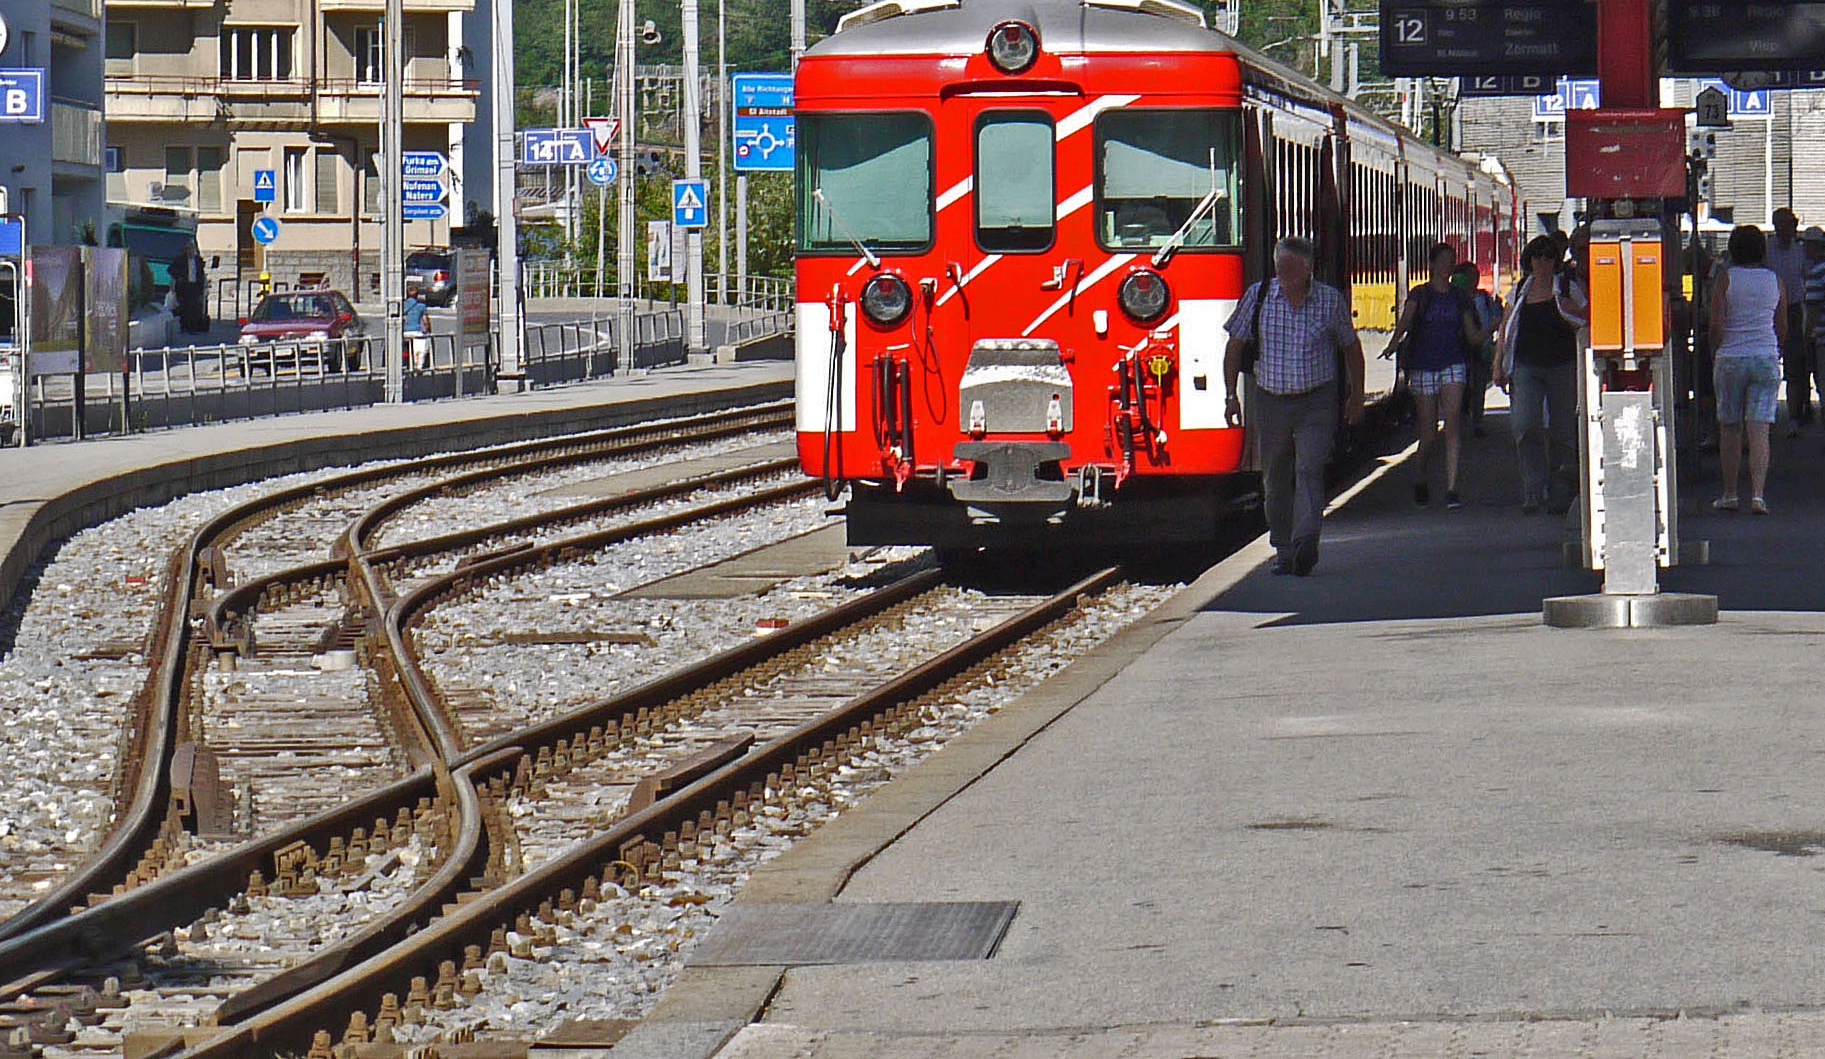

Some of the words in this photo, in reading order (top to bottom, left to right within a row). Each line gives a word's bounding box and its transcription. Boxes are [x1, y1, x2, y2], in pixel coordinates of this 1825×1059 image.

[1394, 19, 1424, 42] 12
[7, 89, 27, 114] B
[1543, 95, 1564, 111] 12
[1582, 93, 1596, 109] A
[1746, 92, 1761, 109] A
[570, 142, 585, 160] A
